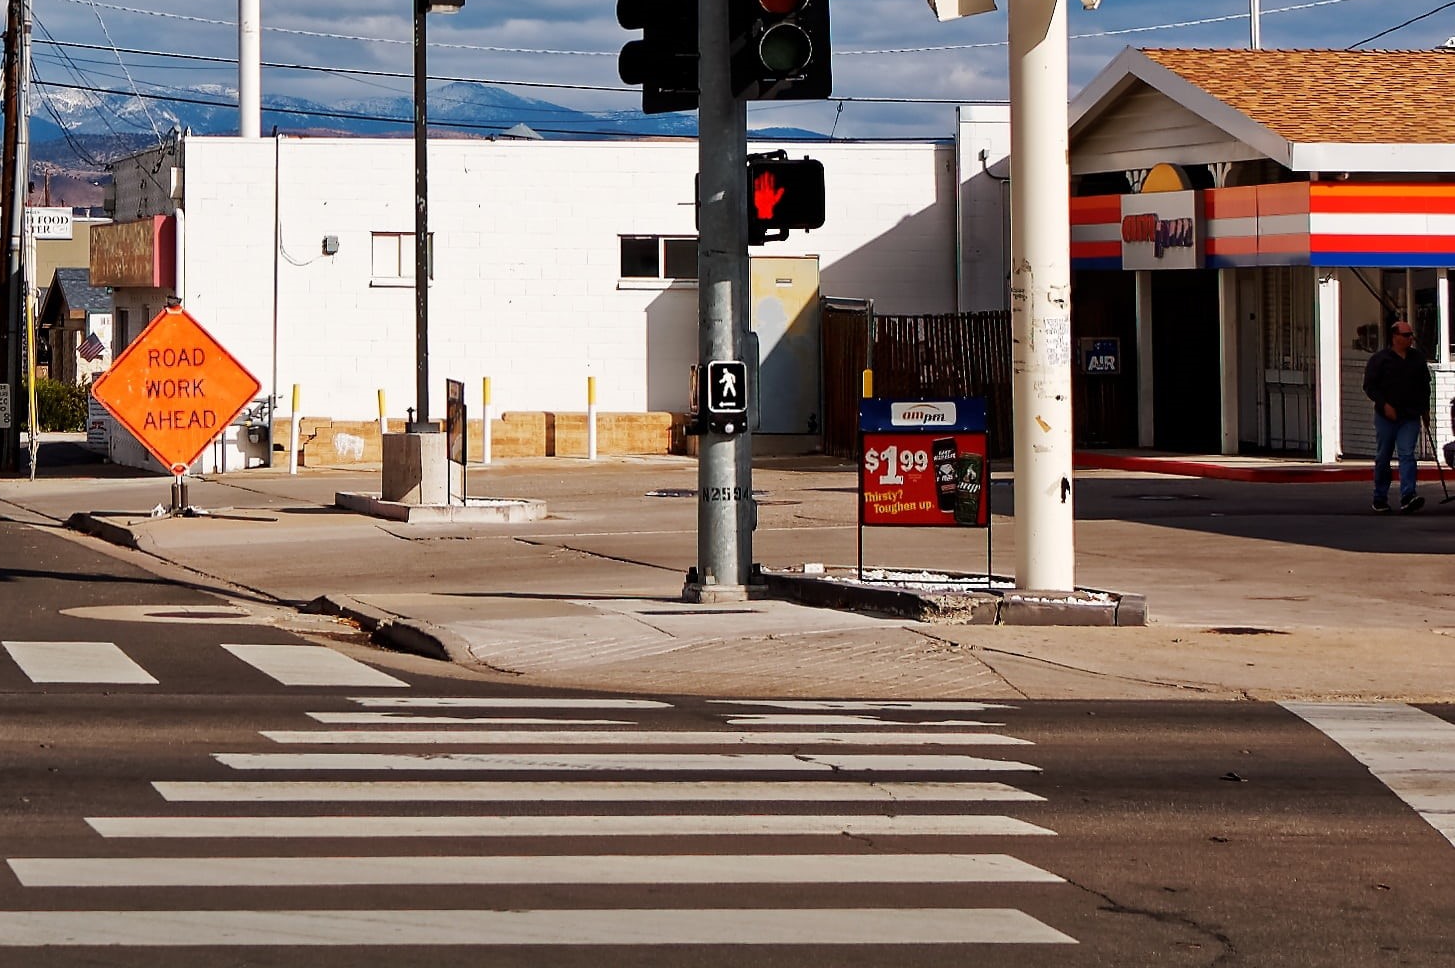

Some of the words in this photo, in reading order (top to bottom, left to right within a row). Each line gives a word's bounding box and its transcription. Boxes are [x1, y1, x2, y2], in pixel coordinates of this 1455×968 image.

[37, 216, 69, 224] FOOD
[148, 348, 205, 367] ROAD
[1088, 355, 1115, 371] AIR
[145, 378, 205, 399] WORK
[143, 410, 216, 430] AHEAD
[902, 412, 946, 424] ampm
[864, 490, 904, 503] Thirsty?
[874, 501, 917, 514] Toughen
